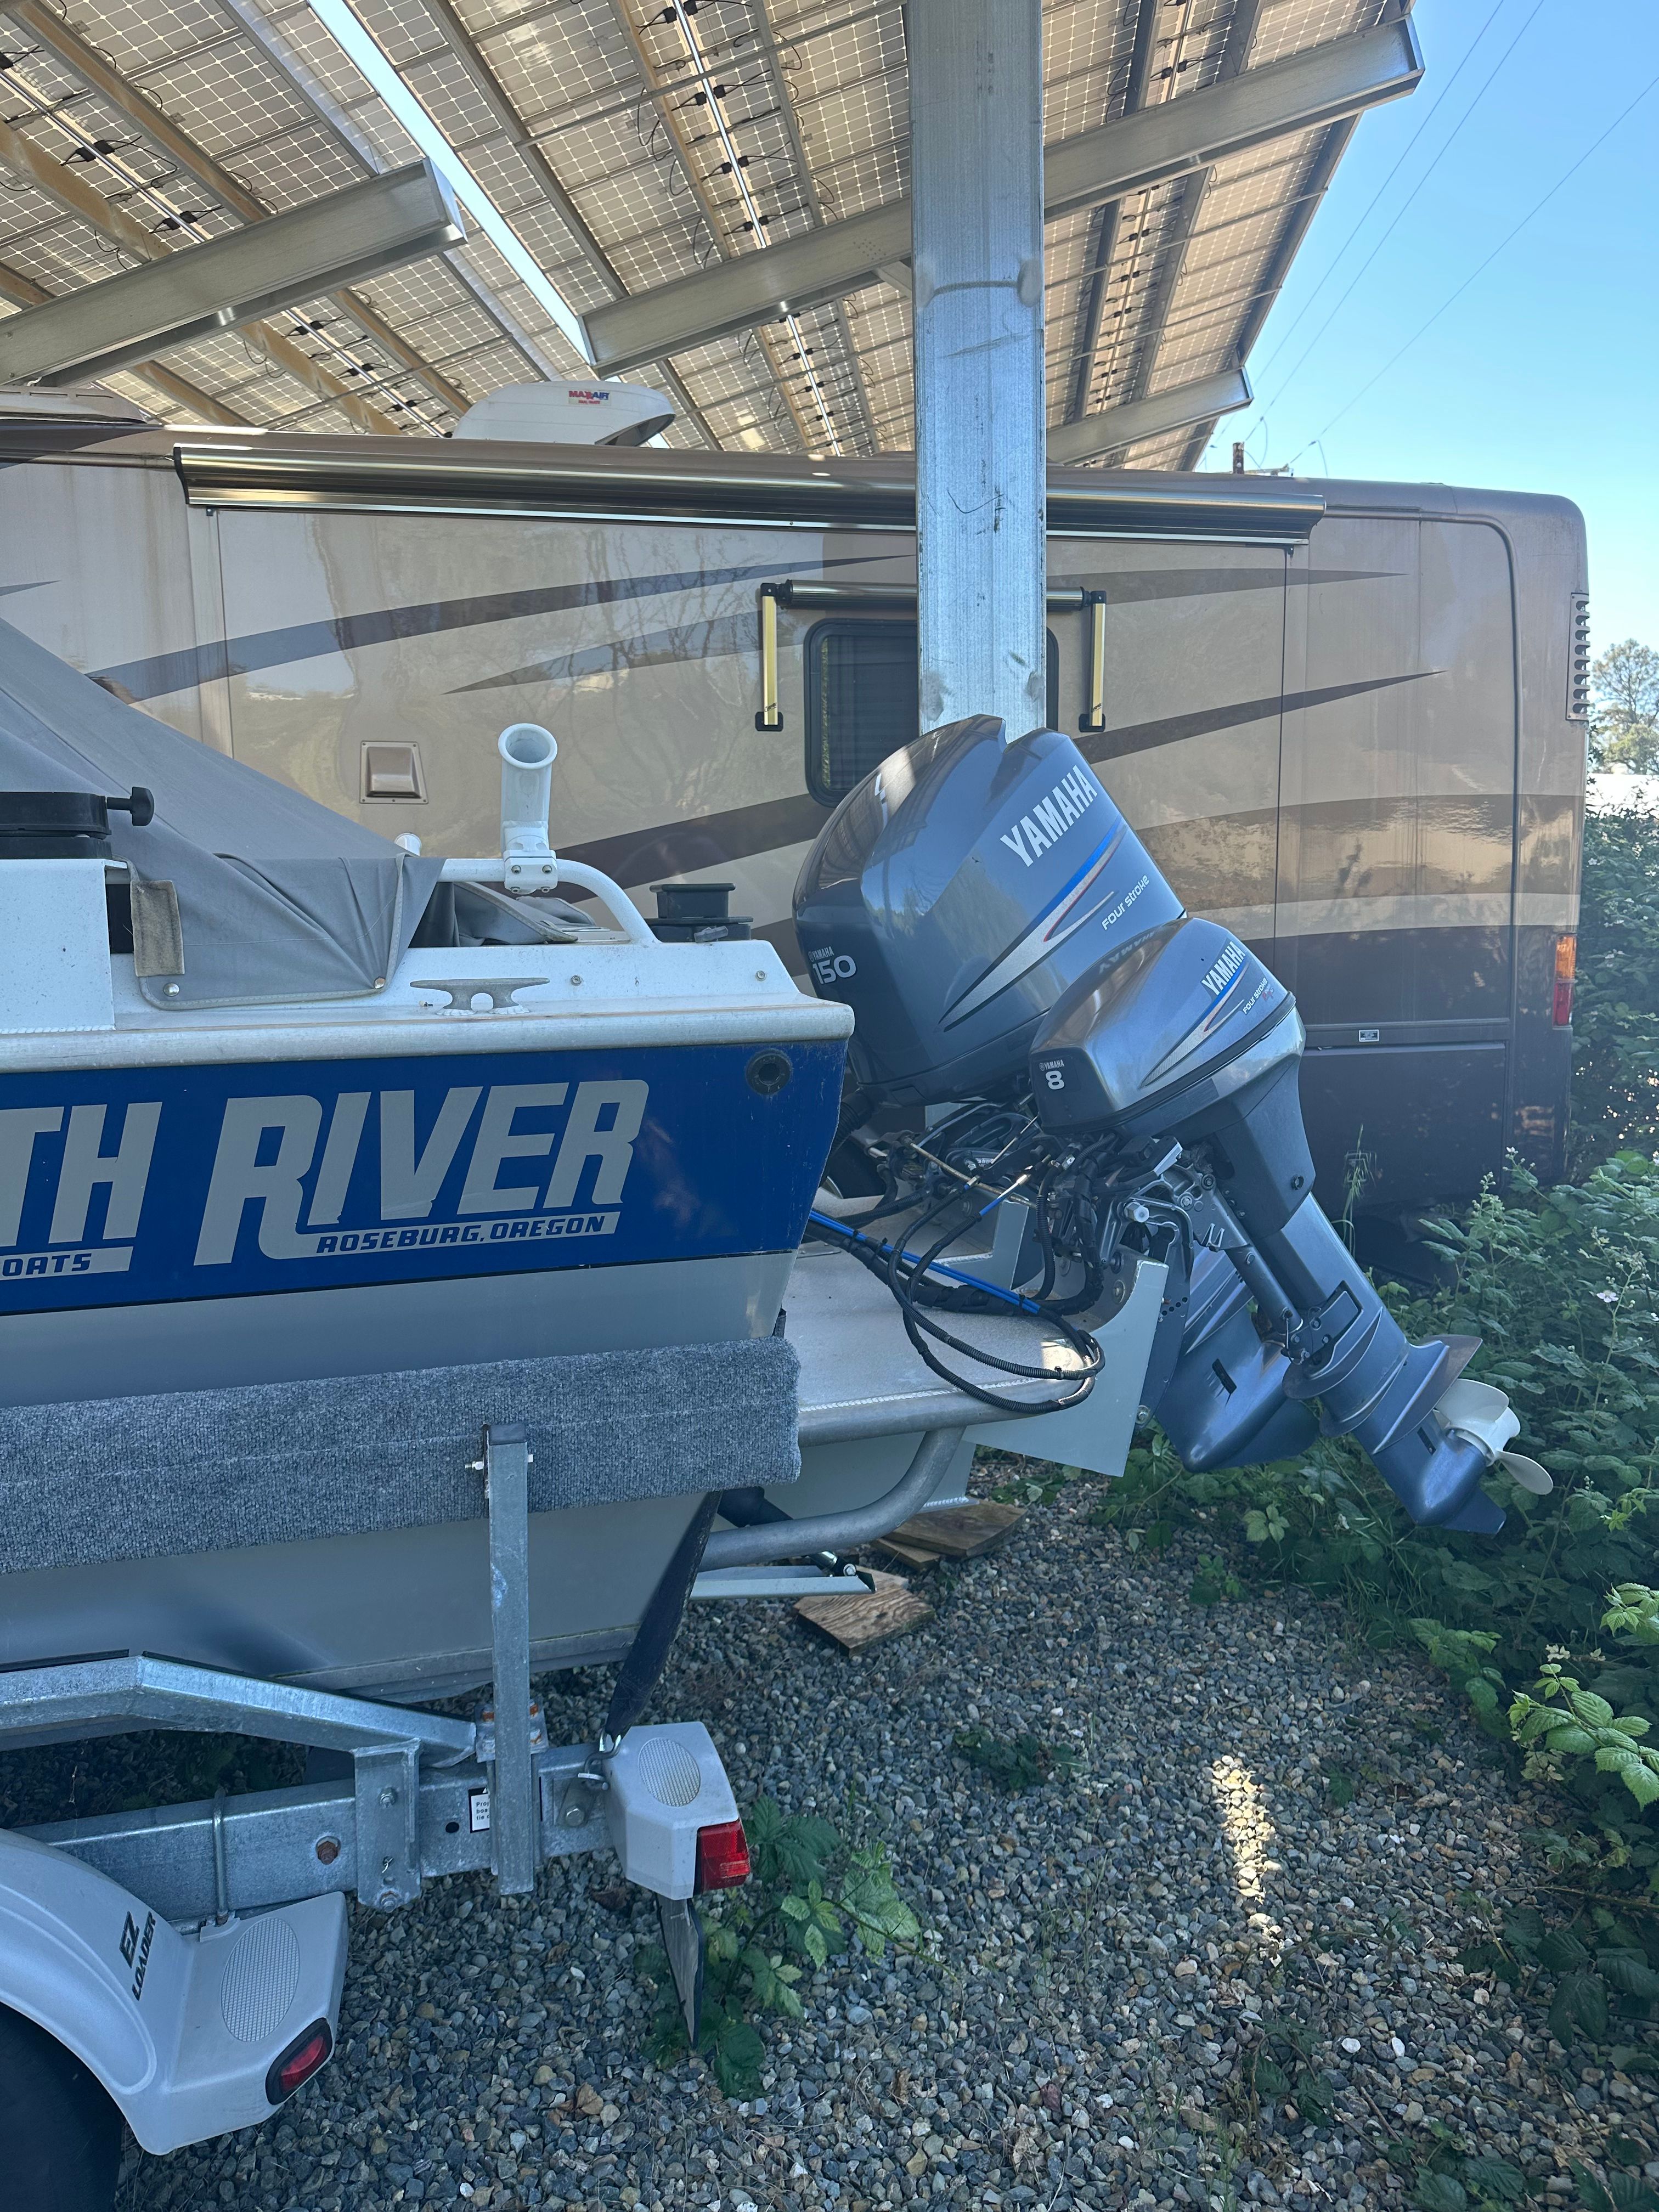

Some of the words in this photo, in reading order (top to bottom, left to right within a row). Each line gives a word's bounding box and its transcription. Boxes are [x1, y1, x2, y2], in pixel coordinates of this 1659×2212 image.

[1000, 765, 1098, 867] YAMAHA
[812, 946, 834, 961] YAMAHA
[812, 955, 856, 984] 150
[1201, 941, 1246, 996] YAMAHA
[1043, 1059, 1065, 1070] YAMAHA
[1045, 1070, 1065, 1090] 8
[194, 1079, 650, 1266] RIVER
[490, 1215, 605, 1239] OREGON
[119, 1911, 140, 1969] EZ
[132, 1911, 156, 2001] LOADER
